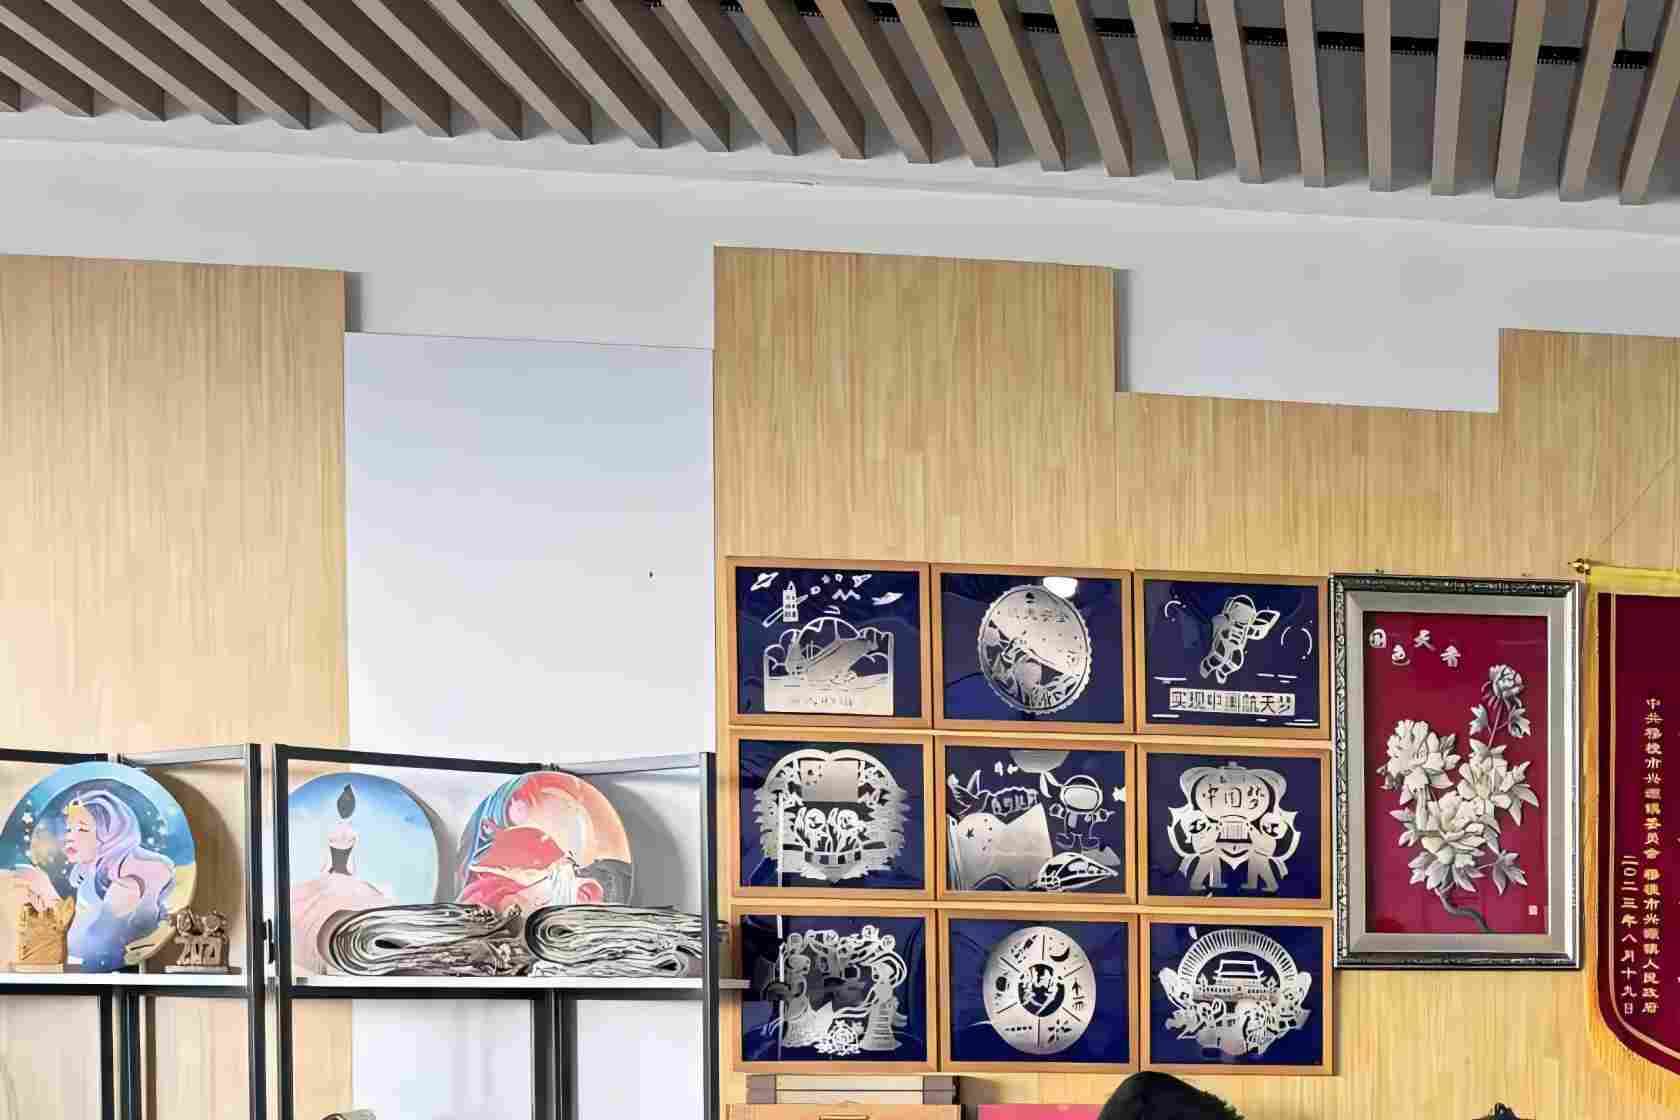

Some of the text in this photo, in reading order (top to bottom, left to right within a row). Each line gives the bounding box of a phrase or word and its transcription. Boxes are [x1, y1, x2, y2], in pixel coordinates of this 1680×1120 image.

[1369, 629, 1461, 667] 国色天香
[1171, 689, 1292, 714] 实现中国航天梦
